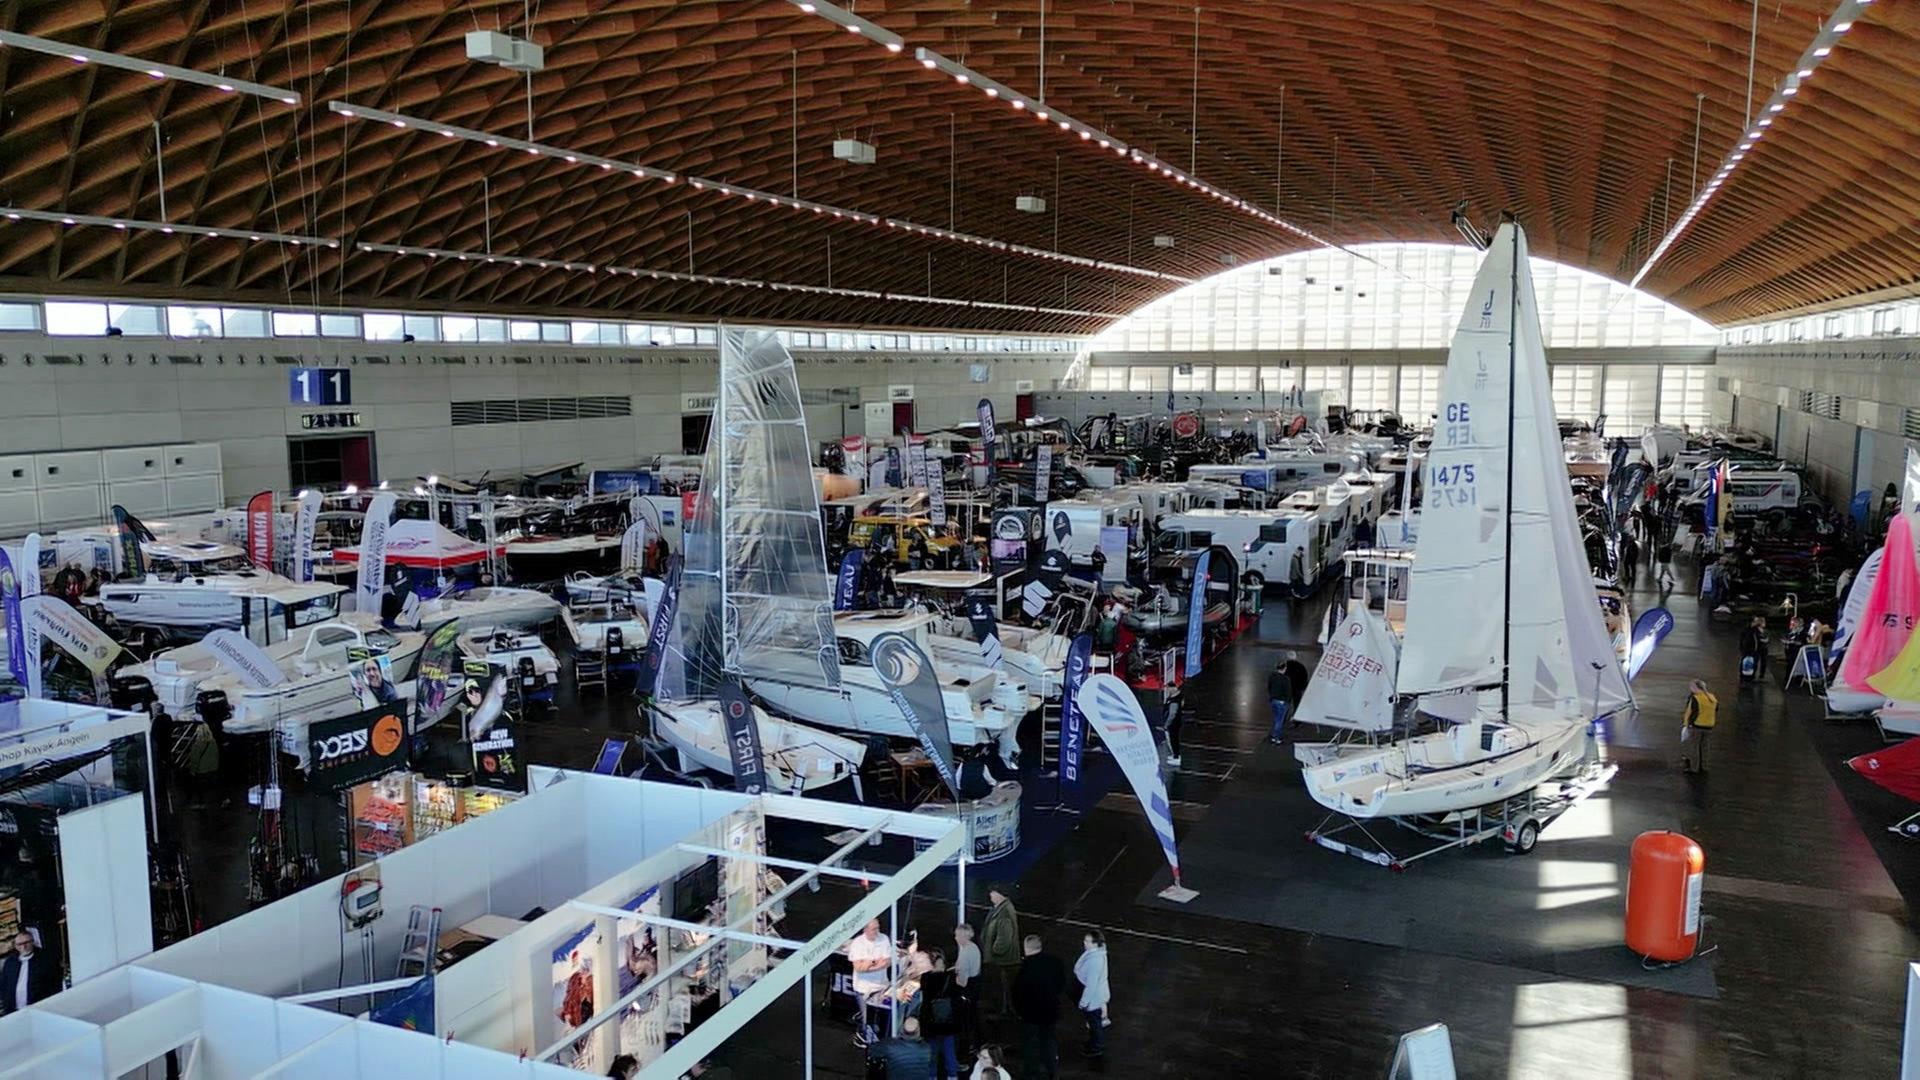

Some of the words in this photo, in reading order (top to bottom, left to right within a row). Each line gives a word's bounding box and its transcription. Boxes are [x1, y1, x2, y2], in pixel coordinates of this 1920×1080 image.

[296, 370, 310, 403] 1
[329, 371, 342, 403] 1
[1447, 402, 1470, 423] GE
[1431, 464, 1476, 487] 1475
[254, 511, 269, 567] YAMAHA
[654, 604, 672, 650] FIRST
[490, 728, 509, 740] NEW
[1065, 655, 1084, 782] BENETEAU
